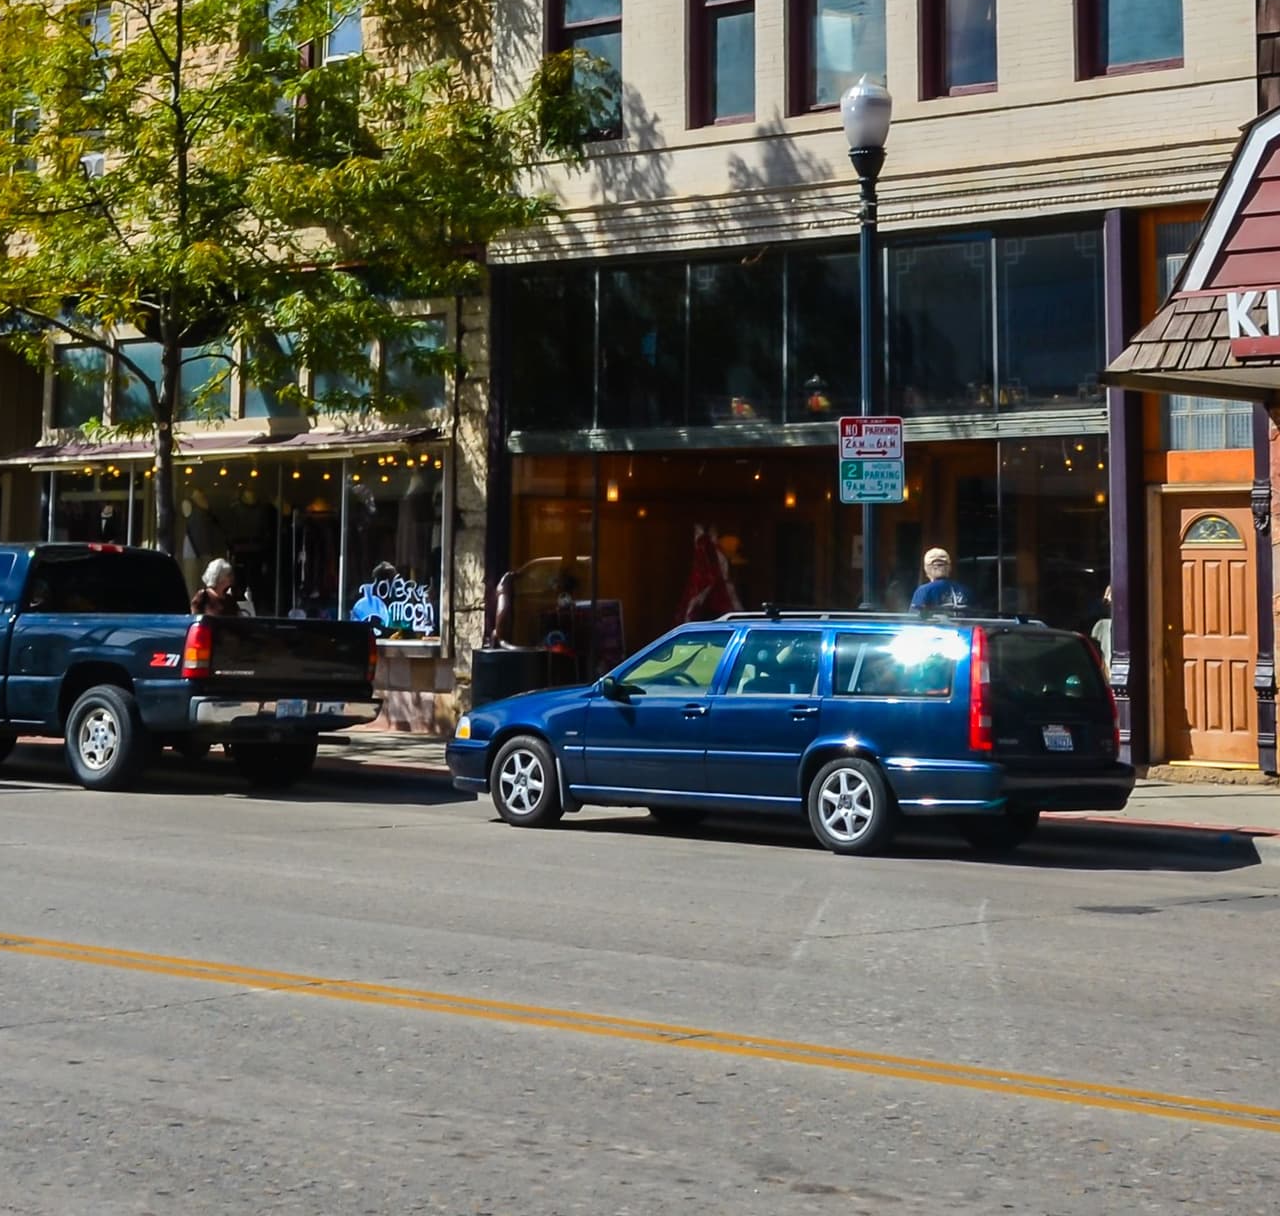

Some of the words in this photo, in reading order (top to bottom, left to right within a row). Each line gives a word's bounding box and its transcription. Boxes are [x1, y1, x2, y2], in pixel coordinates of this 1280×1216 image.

[845, 424, 858, 436] NO
[865, 426, 898, 435] PARKING
[848, 464, 857, 477] 2
[864, 471, 900, 480] PARKING
[150, 653, 181, 667] Z71
